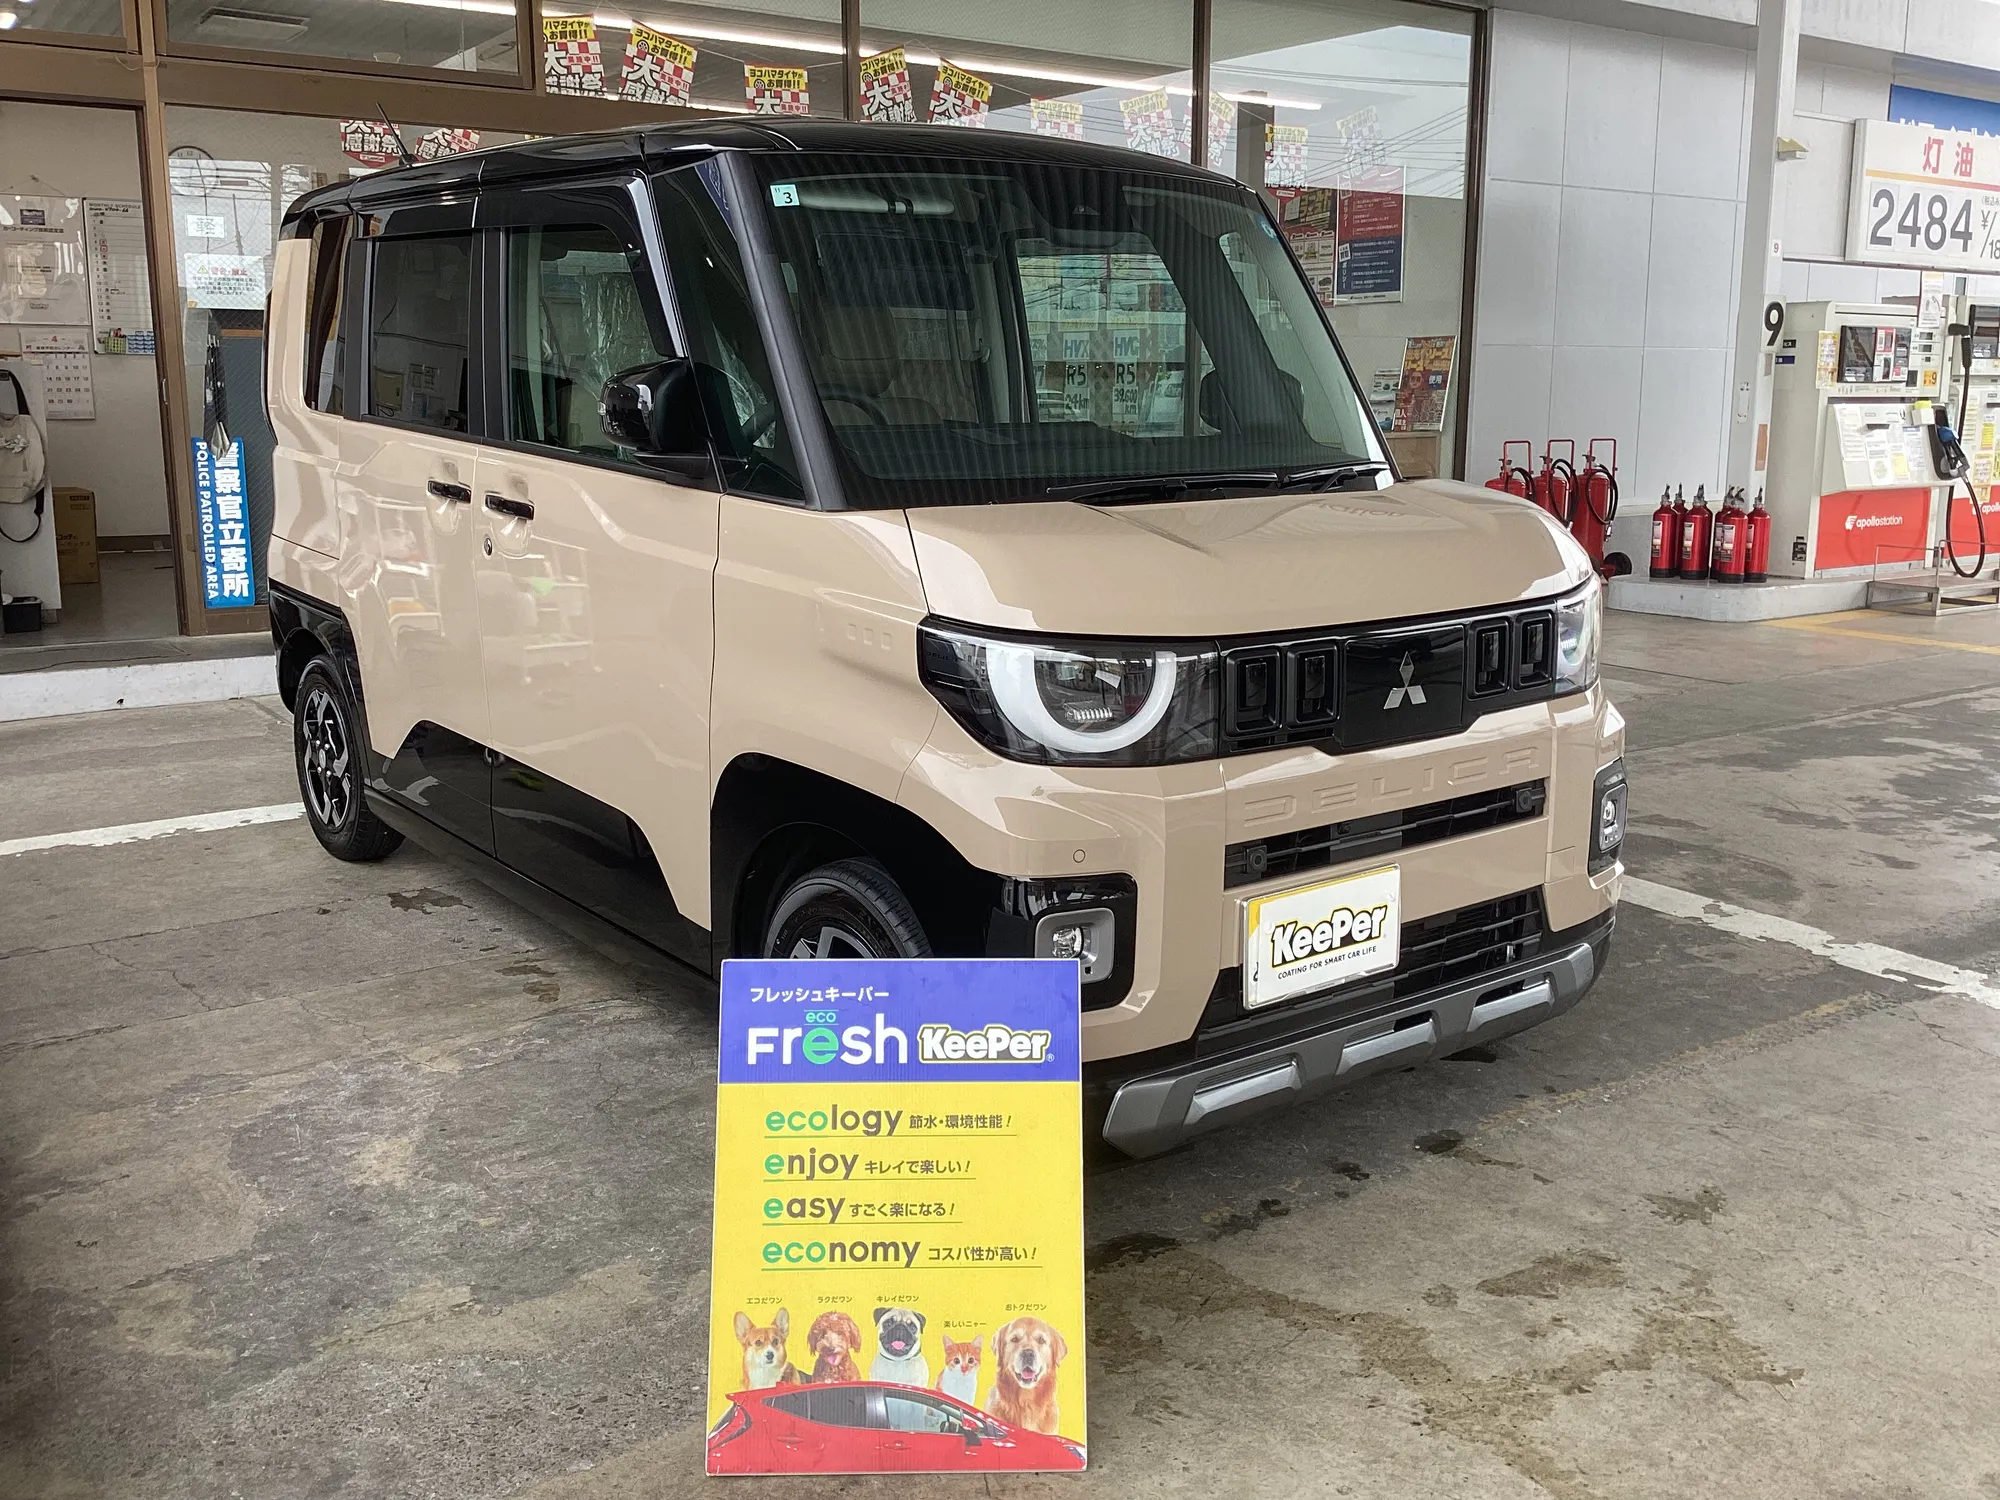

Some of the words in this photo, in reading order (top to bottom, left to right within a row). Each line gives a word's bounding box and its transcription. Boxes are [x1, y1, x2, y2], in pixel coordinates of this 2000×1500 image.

[549, 29, 588, 40] お買得!!
[634, 28, 693, 57] ヨコハマタイヤが
[545, 43, 568, 74] 大
[650, 45, 687, 65] お買得!!
[628, 55, 661, 87] 大
[750, 69, 803, 79] ヨコハマタイヤが
[767, 79, 800, 88] お買得!!
[754, 90, 780, 114] 大
[866, 80, 893, 115] 大
[934, 89, 963, 119] 大
[1922, 136, 1975, 178] 灯油
[782, 192, 793, 204] 3
[1869, 189, 1973, 252] 2484
[1774, 242, 1779, 253] 9
[1764, 301, 1784, 346] 9
[1066, 364, 1087, 386] R5
[1116, 364, 1136, 385] R5
[196, 442, 211, 487] POLICE
[200, 491, 216, 563] PATROLLED
[1856, 514, 1902, 530] apollostation
[206, 566, 219, 600] AREA
[1244, 746, 1540, 827] DELICA
[1271, 905, 1388, 968] KeePer
[1278, 965, 1307, 980] COATING
[1310, 960, 1322, 970] FOR
[1324, 954, 1346, 966] SMART
[1348, 950, 1360, 959] CAR
[1362, 946, 1376, 955] LIFE
[750, 987, 890, 1002] フレッシュキーパー
[805, 1012, 837, 1023] eco
[748, 1013, 908, 1066] Fresh
[920, 1025, 1050, 1063] KeePer
[765, 1104, 904, 1136] ecology
[909, 1114, 1012, 1130] 節水・環境性能!
[764, 1148, 859, 1180] enjoy
[864, 1159, 970, 1176] キレイで楽しい!
[763, 1196, 846, 1224] easy
[849, 1202, 955, 1218] すごく楽になる!
[762, 1240, 921, 1268] economy
[928, 1246, 1037, 1262] コスパ性が高い!
[746, 1296, 783, 1305] エコだワン
[817, 1295, 853, 1304] ラクだワン
[876, 1294, 919, 1304] キレイだワン
[1005, 1303, 1047, 1312] おトクだワン
[943, 1319, 987, 1328] 楽しいニャー
